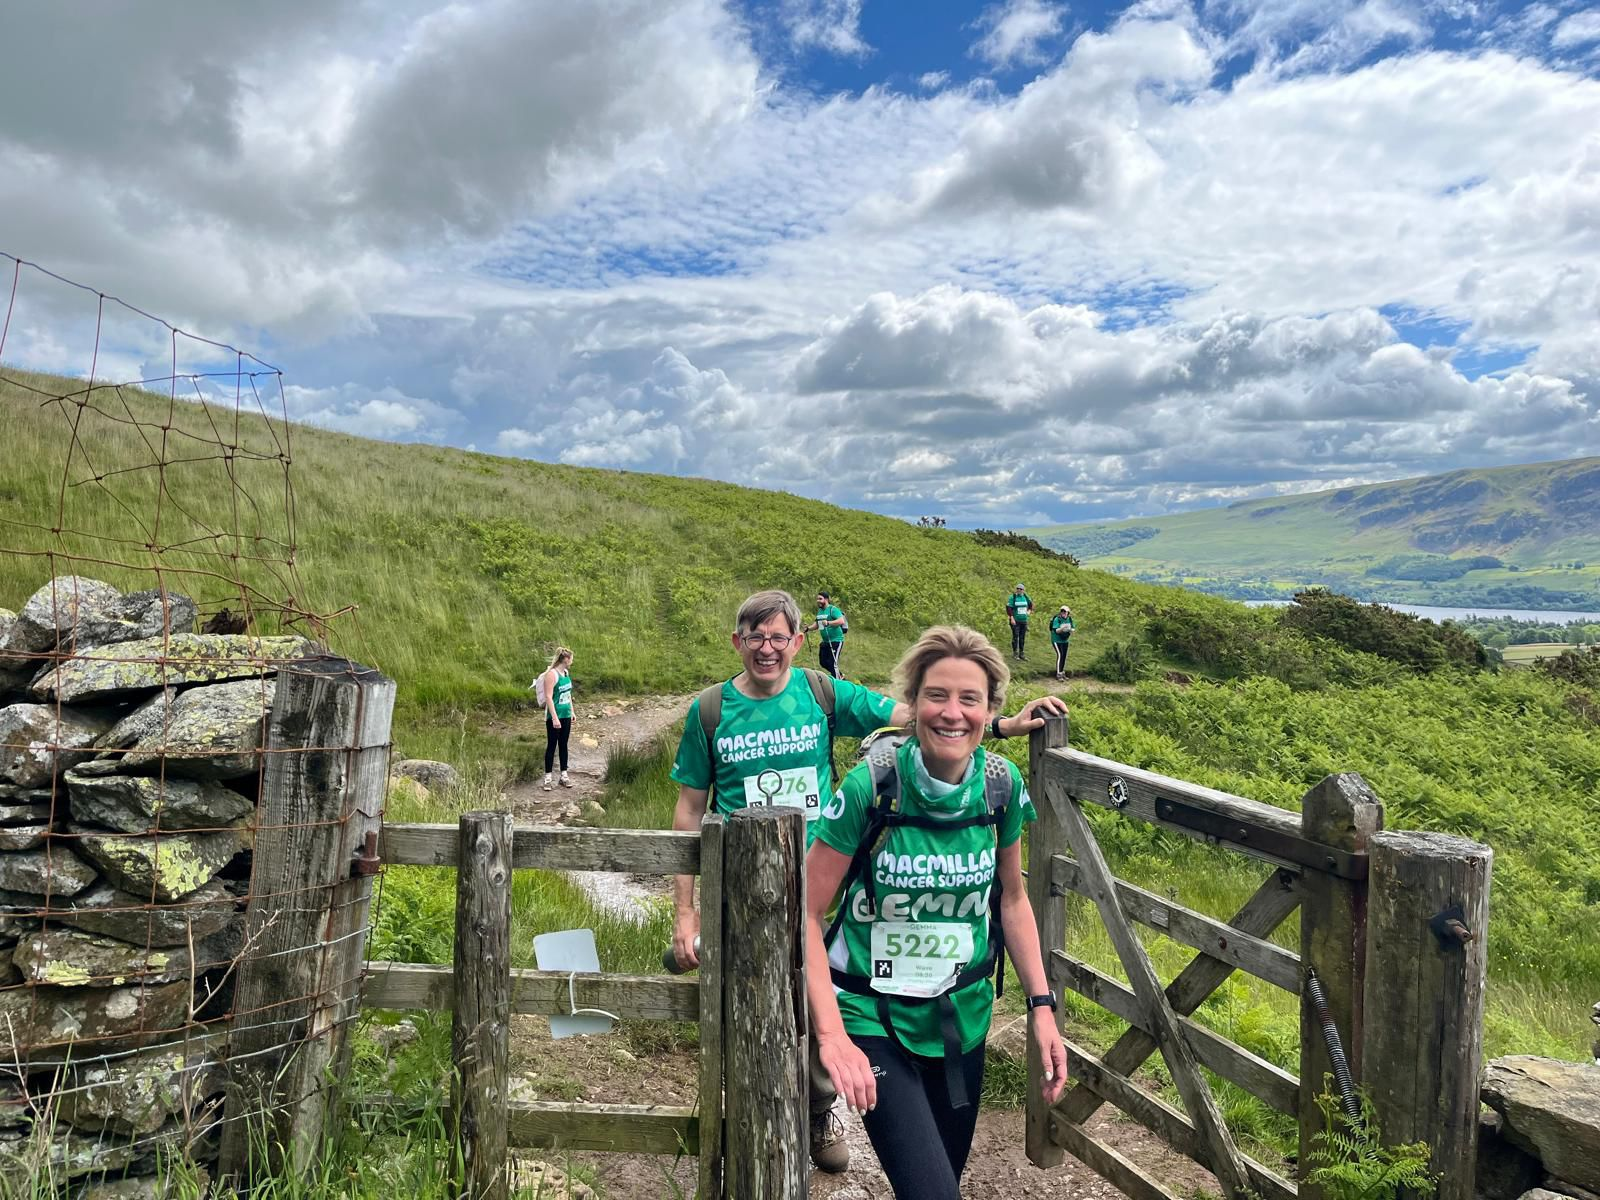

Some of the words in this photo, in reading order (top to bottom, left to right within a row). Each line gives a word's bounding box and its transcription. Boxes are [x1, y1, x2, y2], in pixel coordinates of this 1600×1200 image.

[717, 723, 821, 753] MACMILLAN
[721, 747, 766, 763] CANCER
[768, 738, 818, 756] SUPPORT
[875, 870, 935, 889] CANCER
[885, 933, 960, 959] 5222
